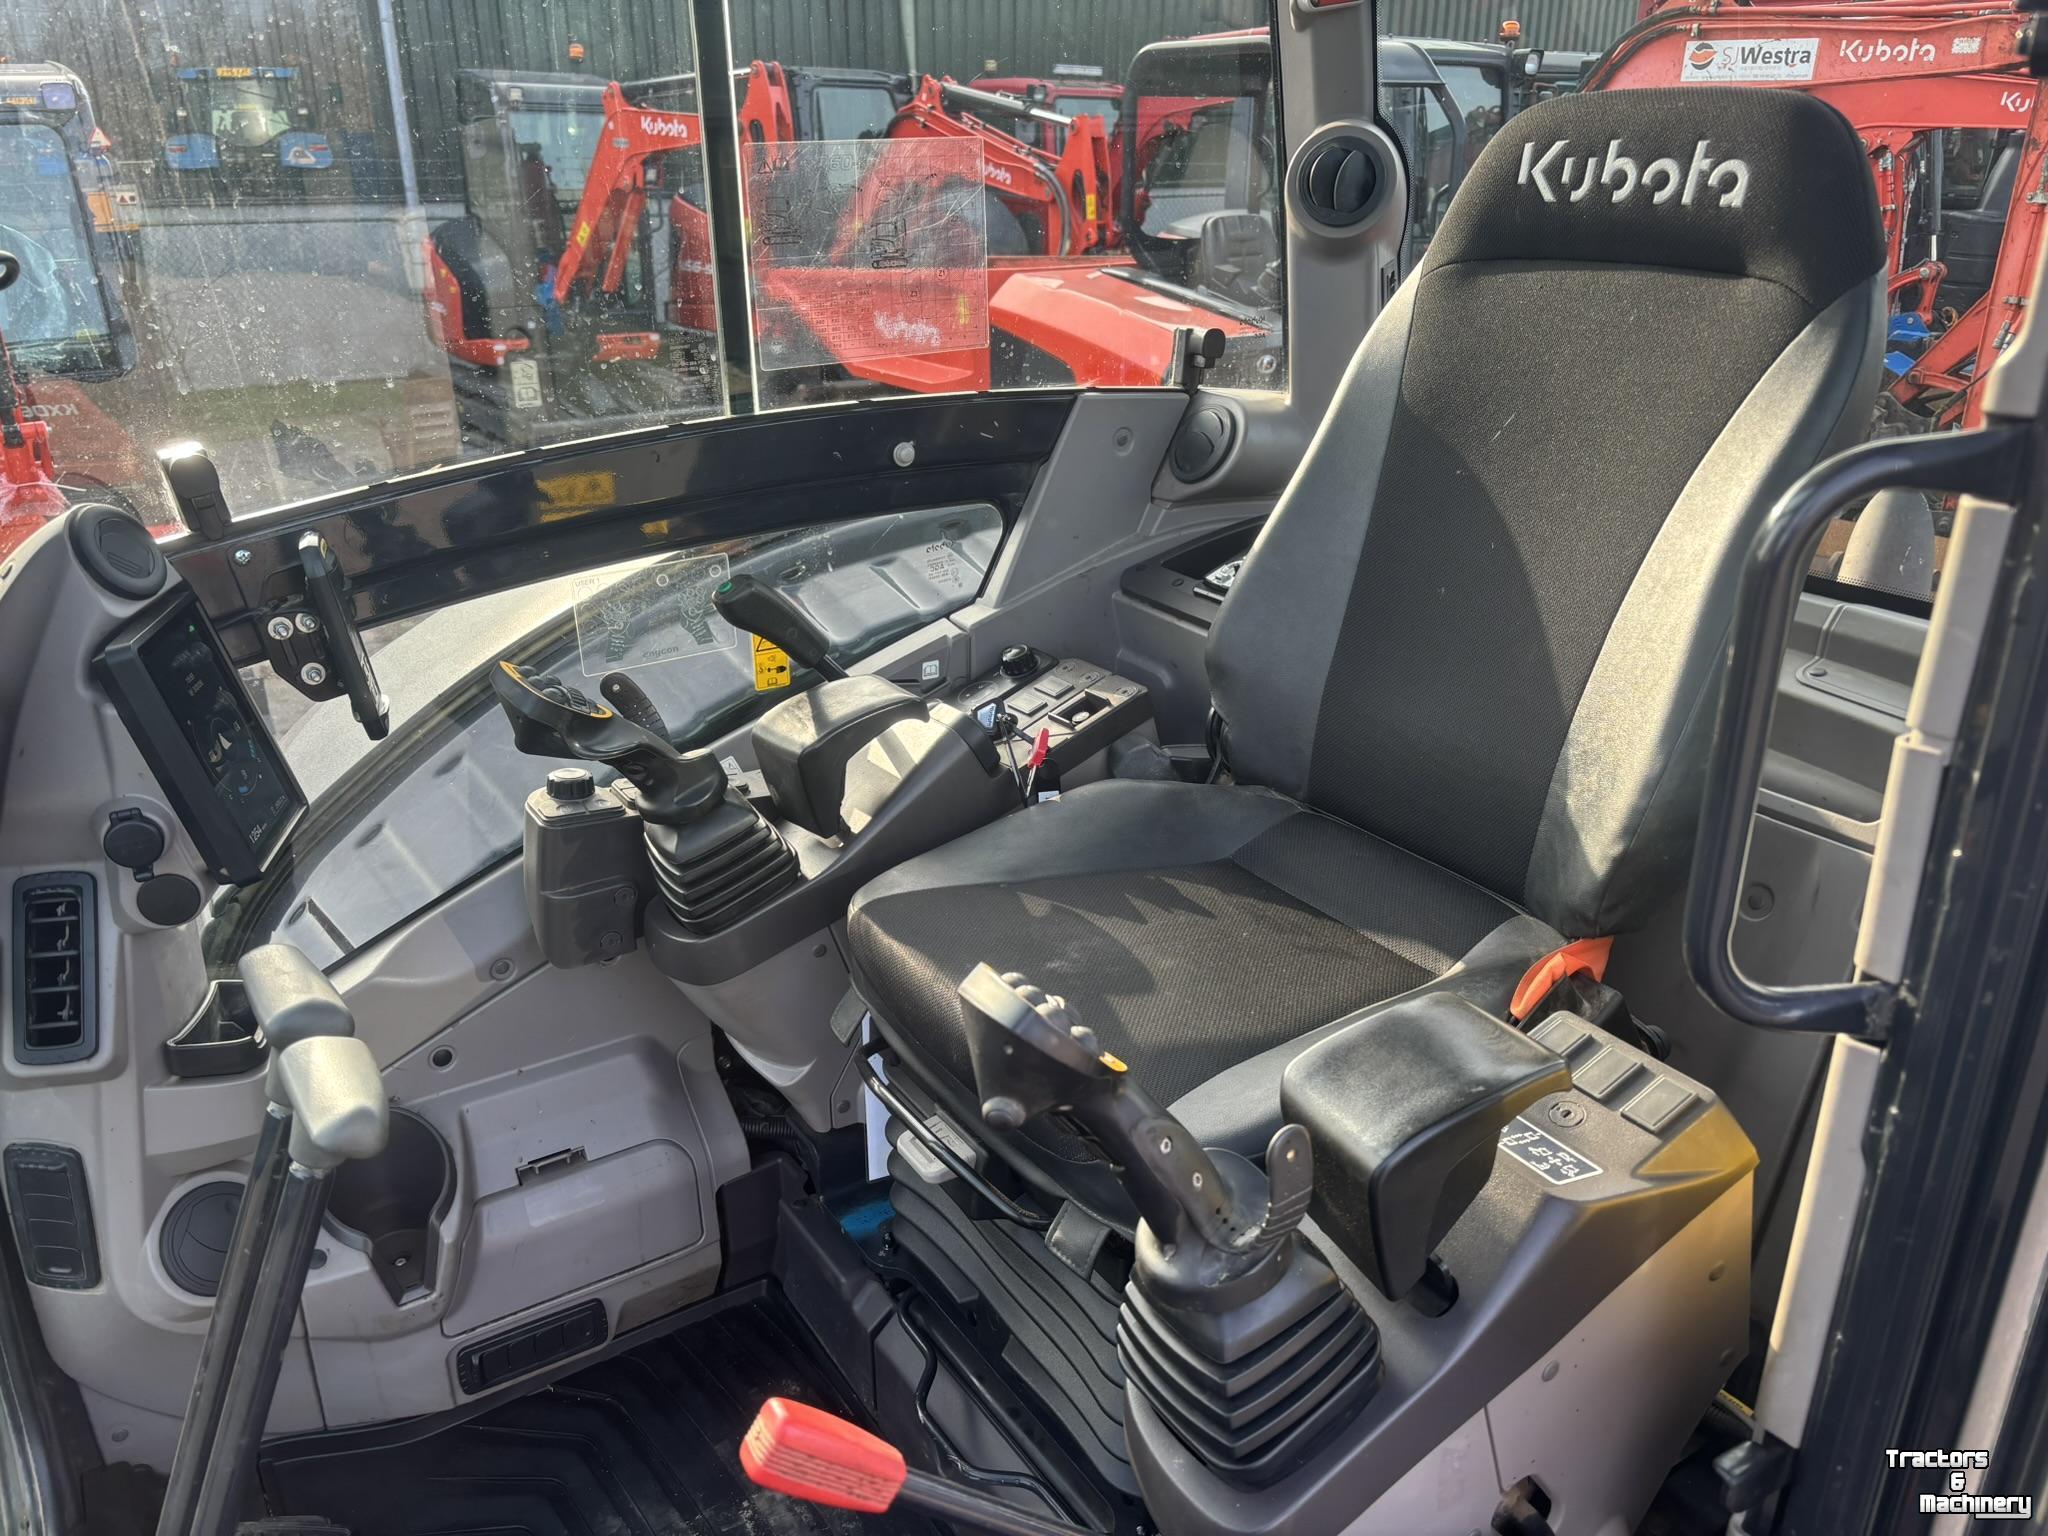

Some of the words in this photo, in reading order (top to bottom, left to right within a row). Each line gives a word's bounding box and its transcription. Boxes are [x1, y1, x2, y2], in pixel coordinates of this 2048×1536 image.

[1839, 38, 1937, 63] Kubota
[2000, 91, 2036, 113] Ku
[640, 116, 688, 138] Kubota
[1517, 139, 1750, 208] Kubota
